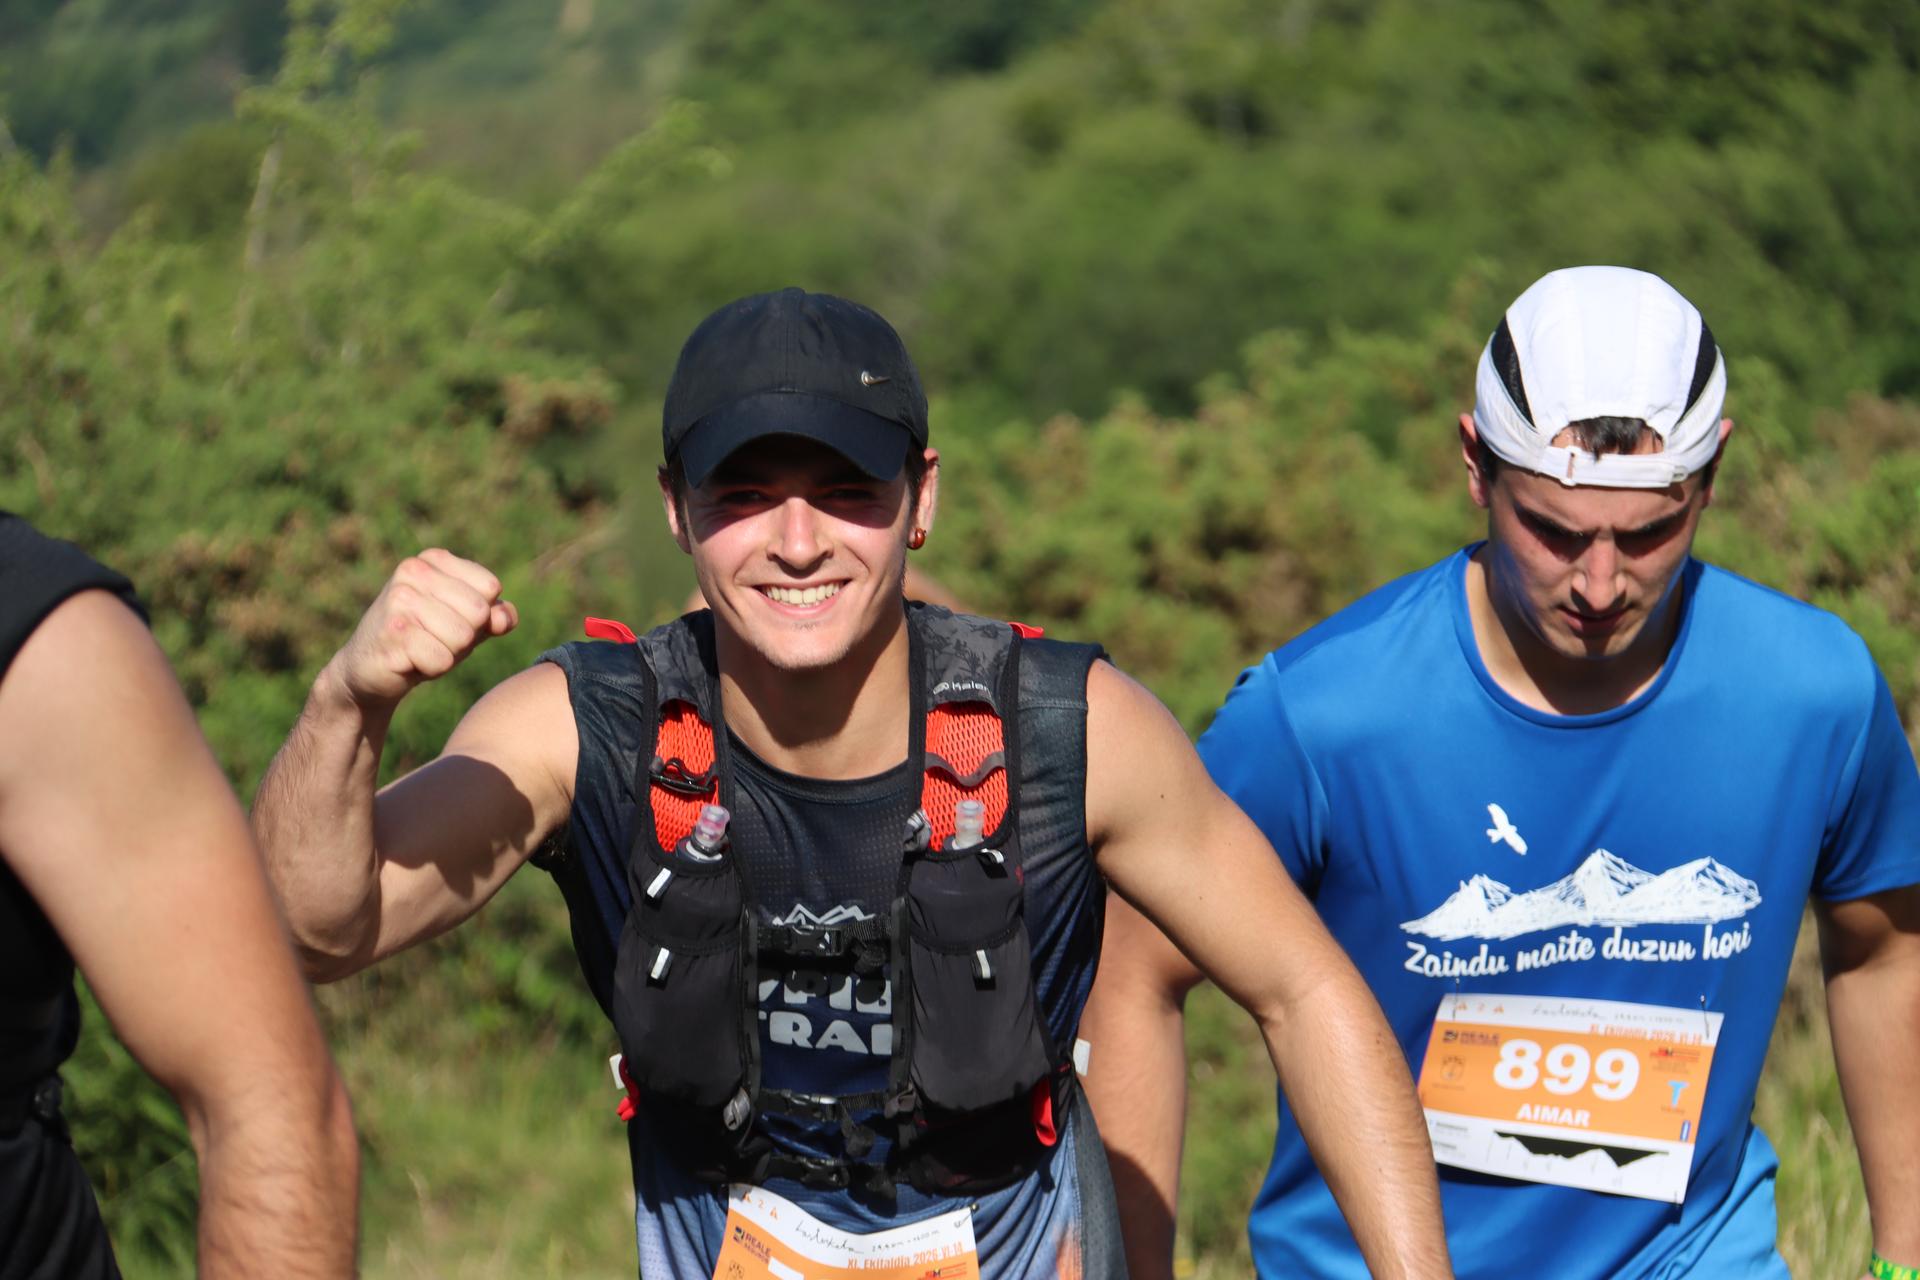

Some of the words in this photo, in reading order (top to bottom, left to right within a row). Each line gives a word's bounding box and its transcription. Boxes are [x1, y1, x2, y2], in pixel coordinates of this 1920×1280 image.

[1404, 940, 1509, 978] Zaindu
[1516, 930, 1596, 972] maite
[1602, 925, 1696, 962] duzun
[1702, 921, 1752, 961] hori
[1493, 1038, 1640, 1102] 899
[1516, 1103, 1590, 1128] AIMAR
